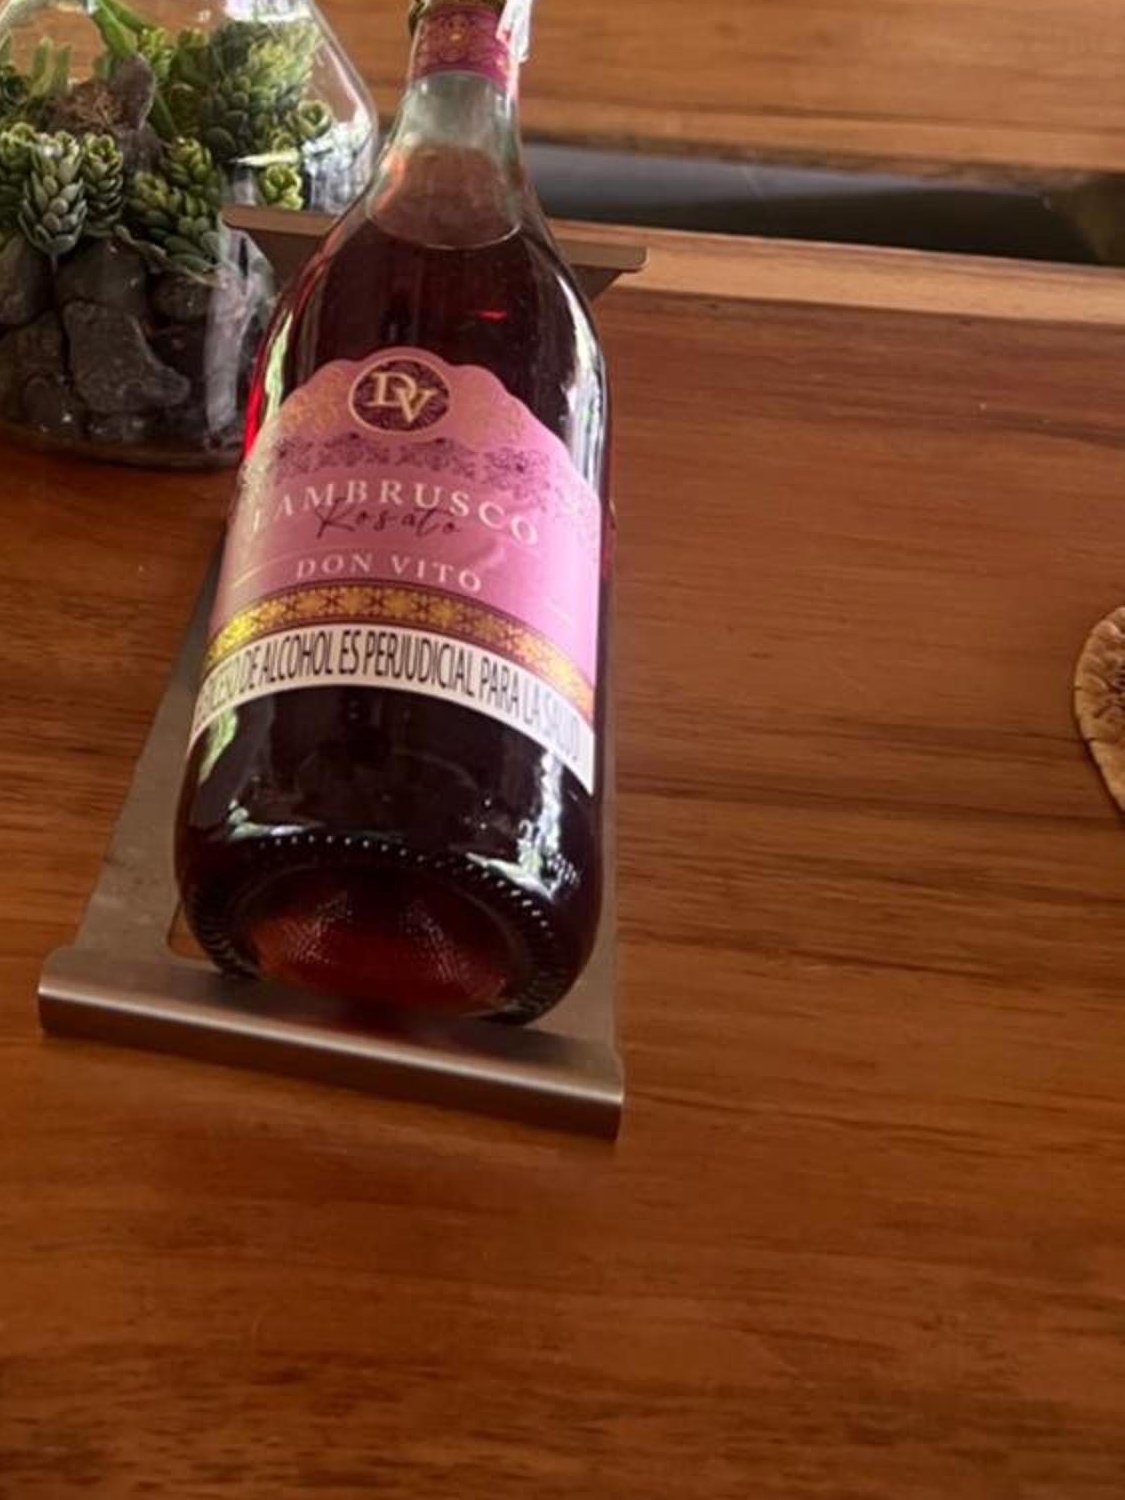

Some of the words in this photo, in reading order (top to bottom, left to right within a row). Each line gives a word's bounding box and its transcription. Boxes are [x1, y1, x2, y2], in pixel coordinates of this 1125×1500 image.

[314, 496, 463, 540] Rosato
[296, 553, 373, 580] DON
[390, 555, 483, 594] VITO
[258, 629, 334, 685] ALCOHOL
[338, 629, 363, 676] ES
[362, 630, 475, 698] PERJUDICIAL
[477, 656, 522, 720] PARA
